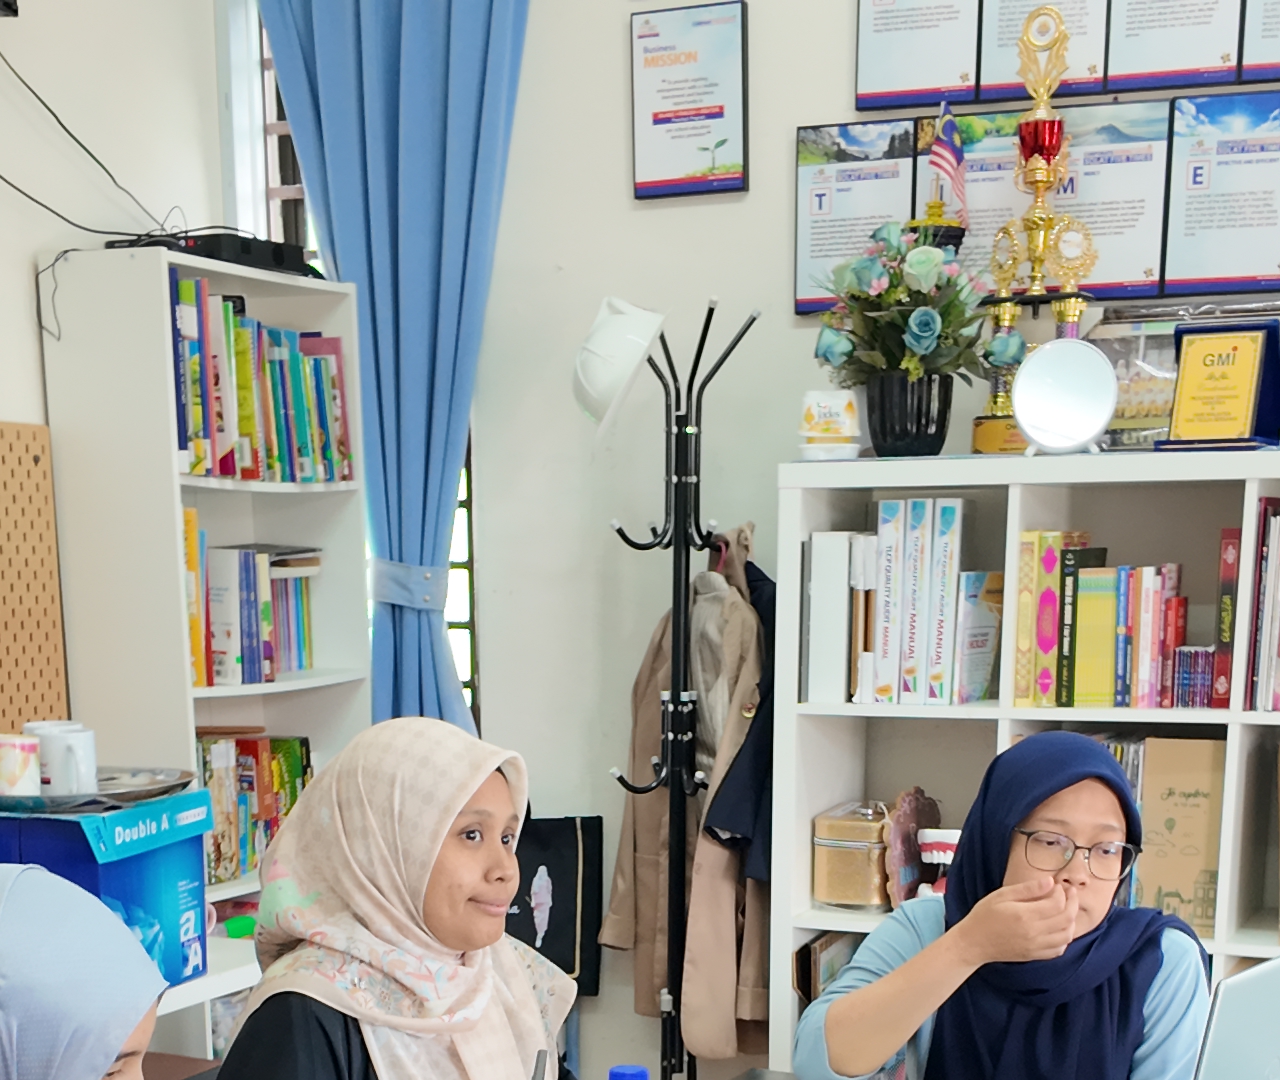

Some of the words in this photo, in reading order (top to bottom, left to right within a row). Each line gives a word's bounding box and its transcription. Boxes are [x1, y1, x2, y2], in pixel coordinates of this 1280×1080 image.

[643, 45, 676, 54] Business
[643, 51, 698, 68] MISSION
[1056, 176, 1075, 195] M
[1192, 166, 1204, 185] E
[814, 193, 826, 210] T
[883, 565, 892, 598] QUALITY
[881, 626, 889, 660] MANUAL
[908, 613, 917, 659] MANUAL
[934, 619, 944, 665] MANUAL
[1178, 789, 1211, 801] explore
[114, 818, 157, 846] Double
[161, 813, 169, 831] A
[179, 910, 197, 943] a
[183, 943, 203, 978] A
